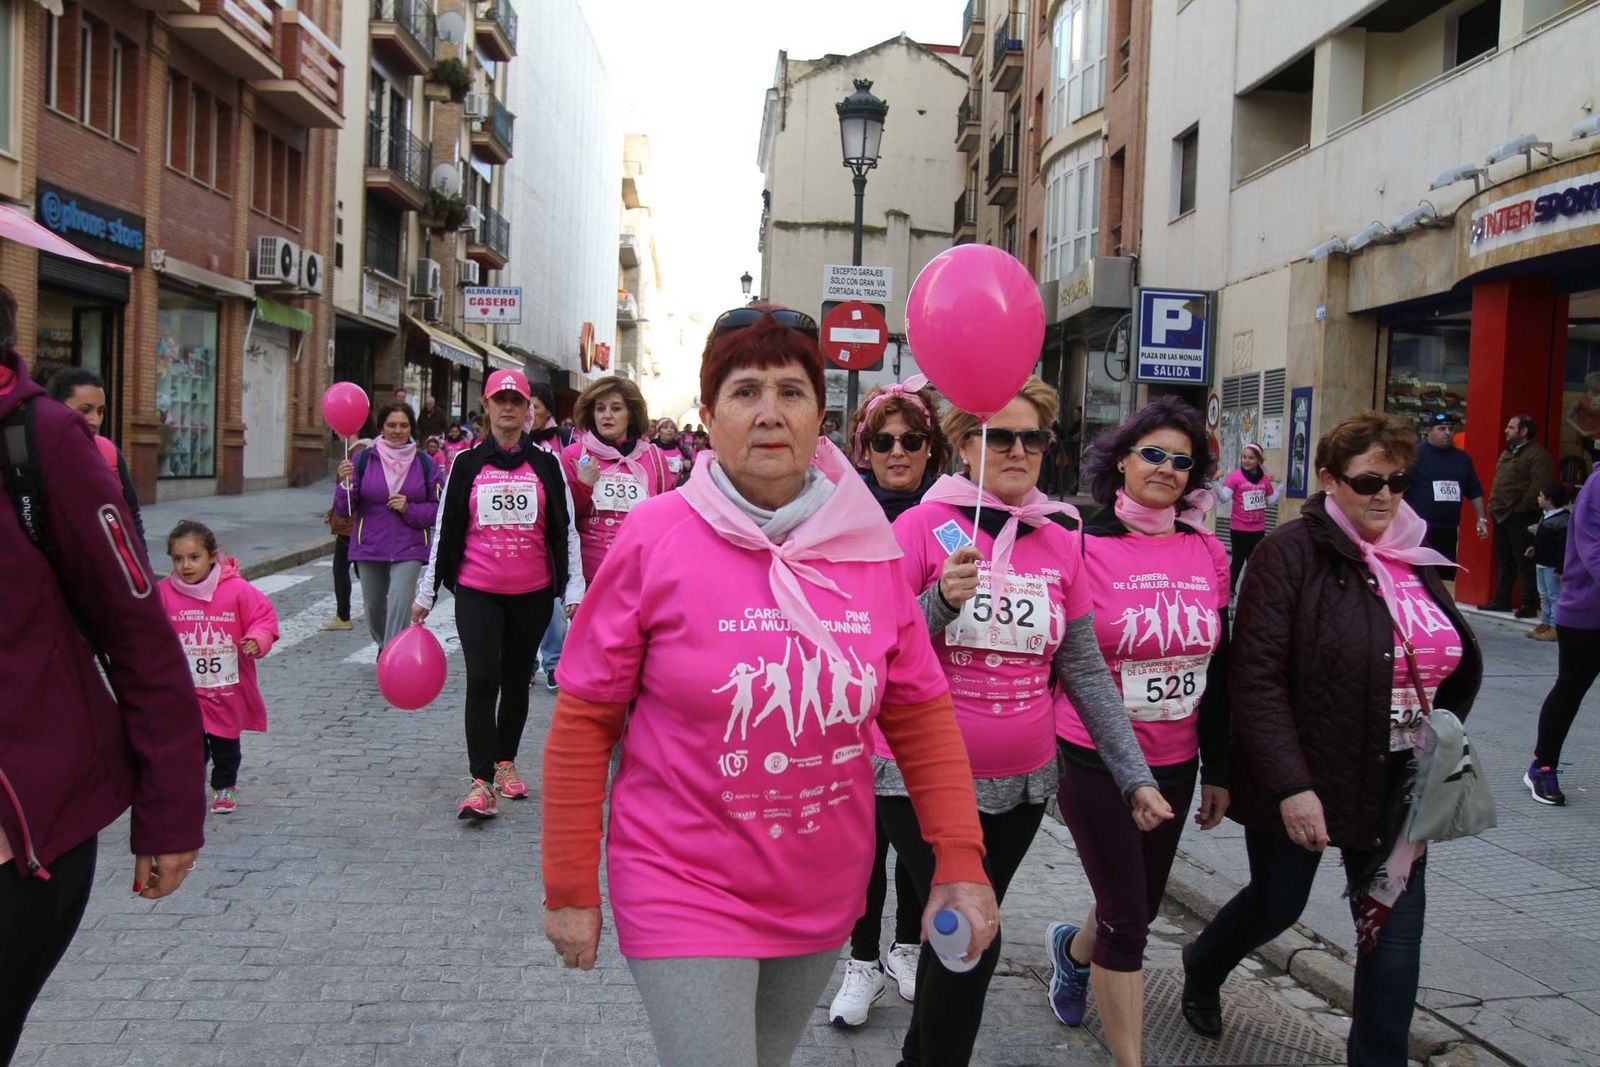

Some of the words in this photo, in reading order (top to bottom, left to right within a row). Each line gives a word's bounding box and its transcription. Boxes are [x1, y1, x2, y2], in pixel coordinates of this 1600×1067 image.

[107, 217, 144, 251] store
[832, 267, 857, 275] EXCEPTO
[859, 268, 884, 277] GARAJES
[830, 276, 846, 284] SOLO
[846, 278, 858, 286] CON
[859, 279, 874, 287] GRAN
[877, 280, 886, 288] VIA
[466, 288, 520, 296] ALMACENES
[828, 286, 854, 295] CORTADA
[864, 289, 887, 297] TRAFICO
[469, 297, 516, 307] CASERO
[1151, 298, 1192, 344] P
[1141, 352, 1158, 360] PLAZA
[1168, 353, 1178, 361] LAS
[1153, 365, 1191, 377] SALIDA
[604, 483, 638, 499] 533
[492, 494, 528, 511] 539
[1129, 573, 1169, 582] CARRERA
[1191, 575, 1208, 584] PINK
[1026, 582, 1043, 590] PINK
[1113, 582, 1125, 590] DE
[1127, 582, 1138, 590] LA
[1140, 581, 1170, 590] MUJER
[1177, 581, 1210, 591] RUNNING
[1010, 587, 1045, 598] RUNNING
[845, 610, 870, 623] PINK
[973, 594, 1035, 628] 532
[718, 620, 737, 632] DE
[740, 620, 757, 632] LA
[821, 620, 872, 634] RUNNING
[195, 657, 222, 675] 85
[1141, 660, 1172, 669] CARRERA
[1149, 665, 1173, 674] MUJER
[1146, 671, 1196, 703] 528
